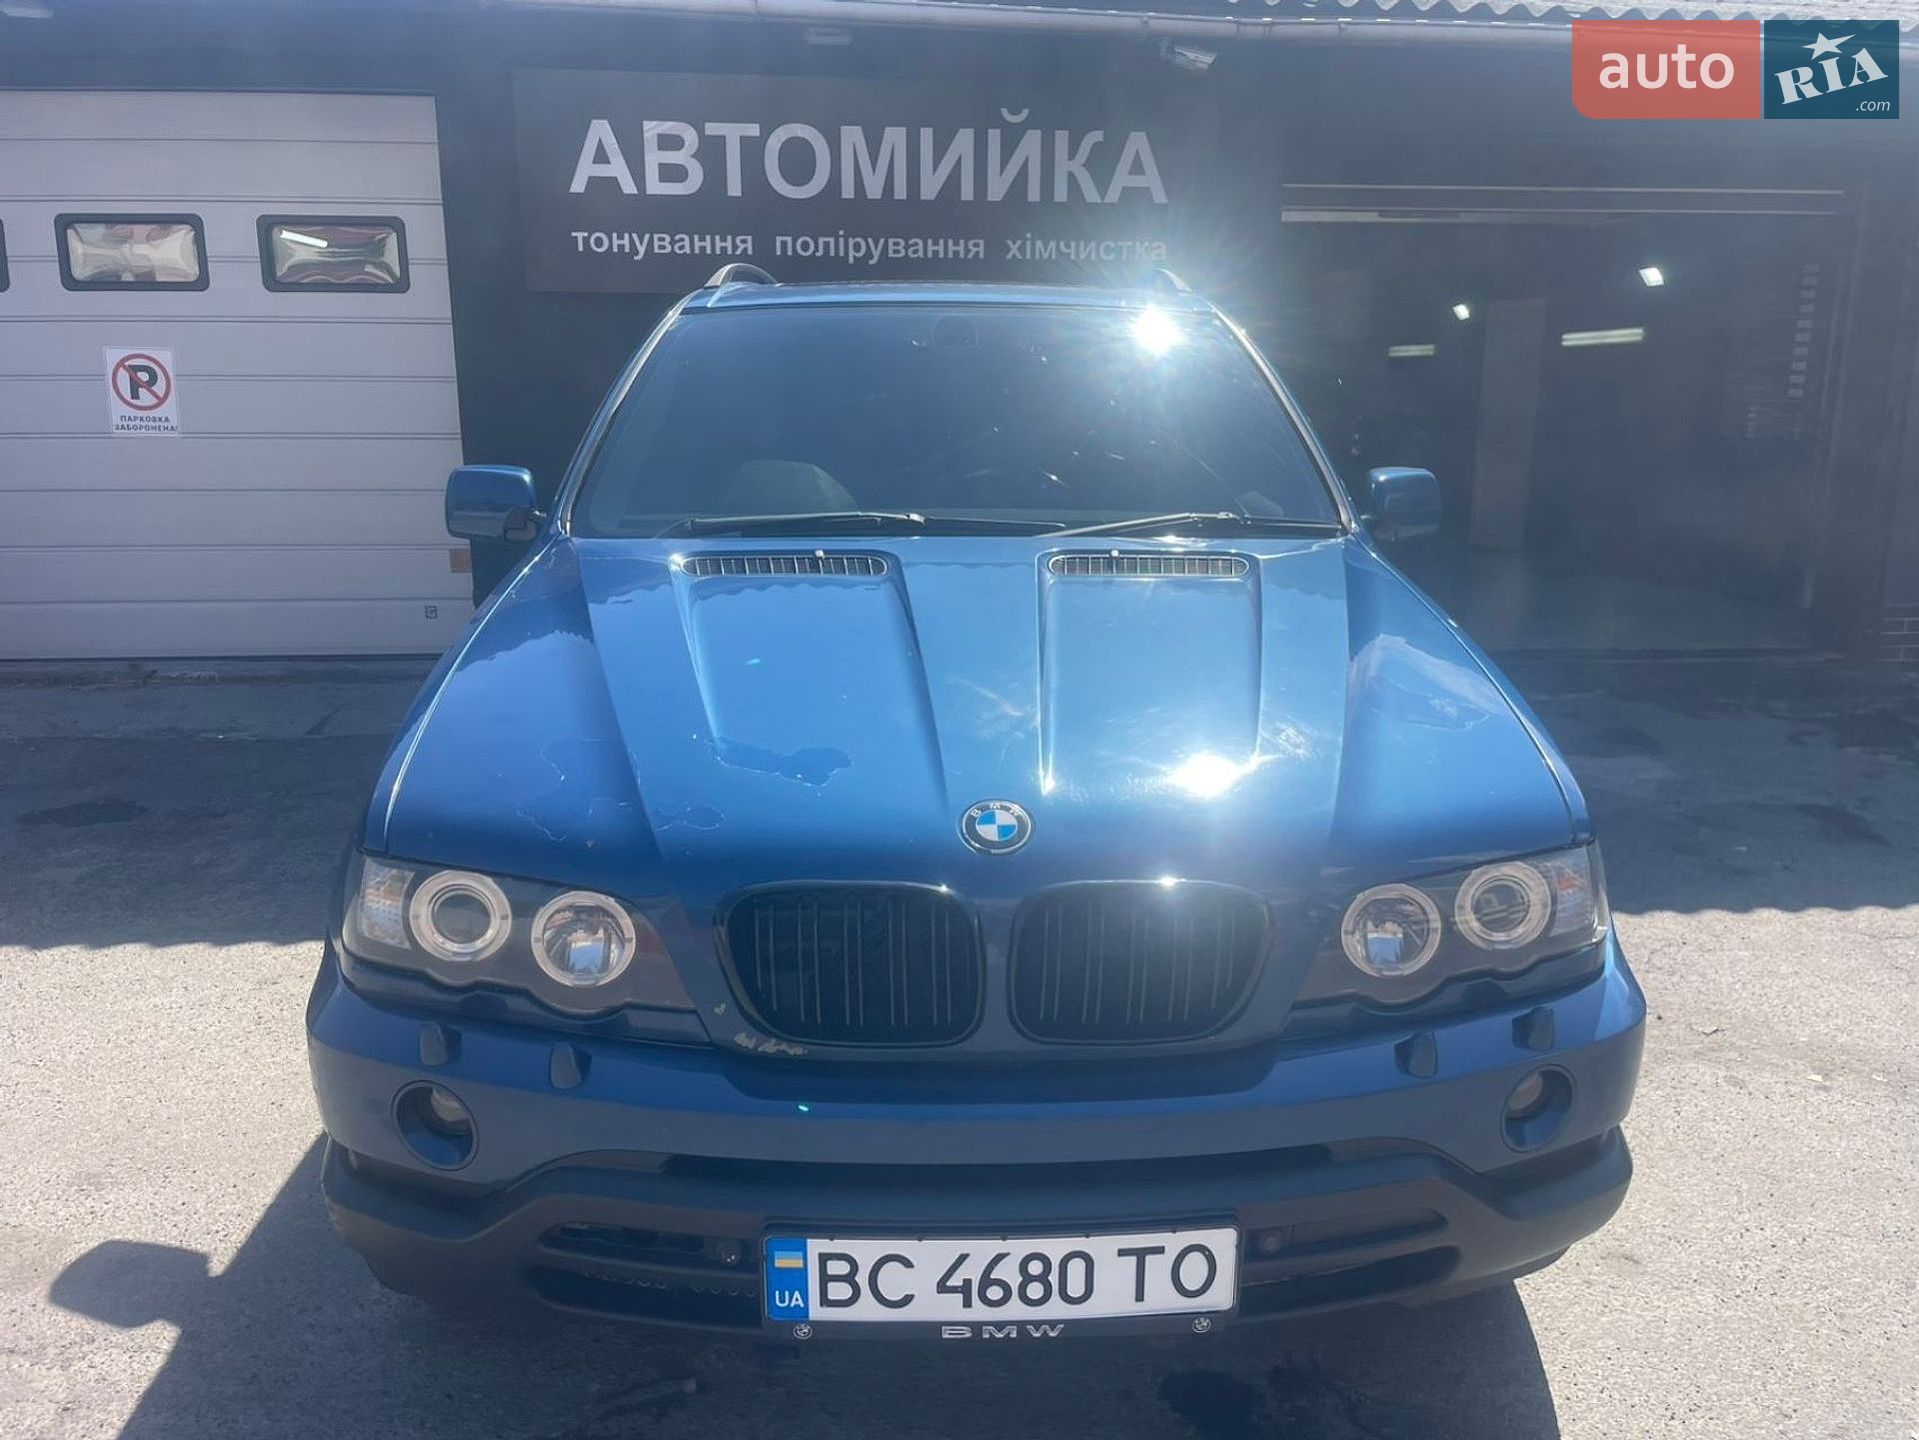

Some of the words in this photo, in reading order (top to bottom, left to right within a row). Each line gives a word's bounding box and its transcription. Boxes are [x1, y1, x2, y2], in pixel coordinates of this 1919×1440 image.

[569, 108, 1169, 204] АВТОМИЙКА
[571, 228, 754, 260] тонування
[775, 230, 985, 264] полірування
[1006, 234, 1167, 262] хімчистка
[119, 415, 170, 423] ПАРКОВКА
[970, 802, 1021, 818] BMW
[818, 1252, 915, 1310] BC
[936, 1250, 1095, 1309] 4680
[1117, 1243, 1217, 1303] TO
[775, 1289, 804, 1308] UA
[941, 1324, 1064, 1339] BMW
